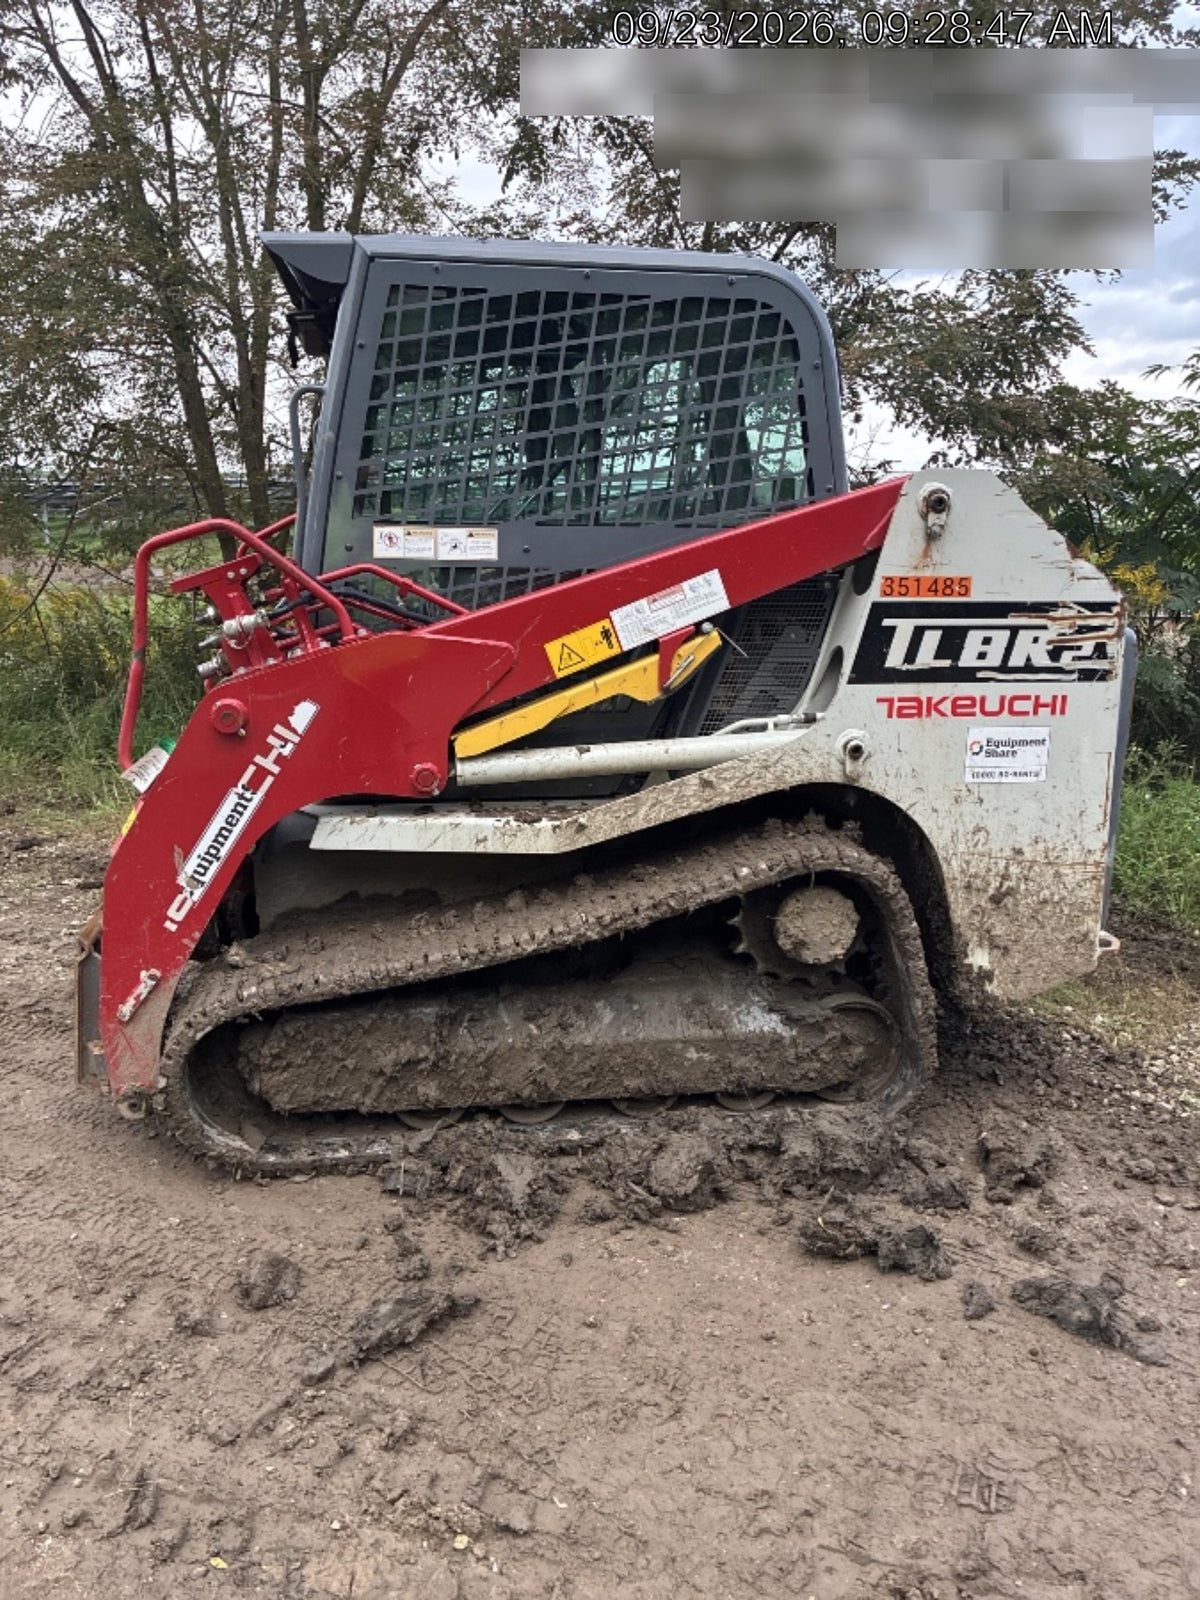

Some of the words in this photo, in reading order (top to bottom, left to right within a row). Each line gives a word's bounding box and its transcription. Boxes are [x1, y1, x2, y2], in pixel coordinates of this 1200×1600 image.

[882, 577, 970, 597] 351485
[985, 738, 1047, 749] Equipment
[984, 748, 1018, 758] Share
